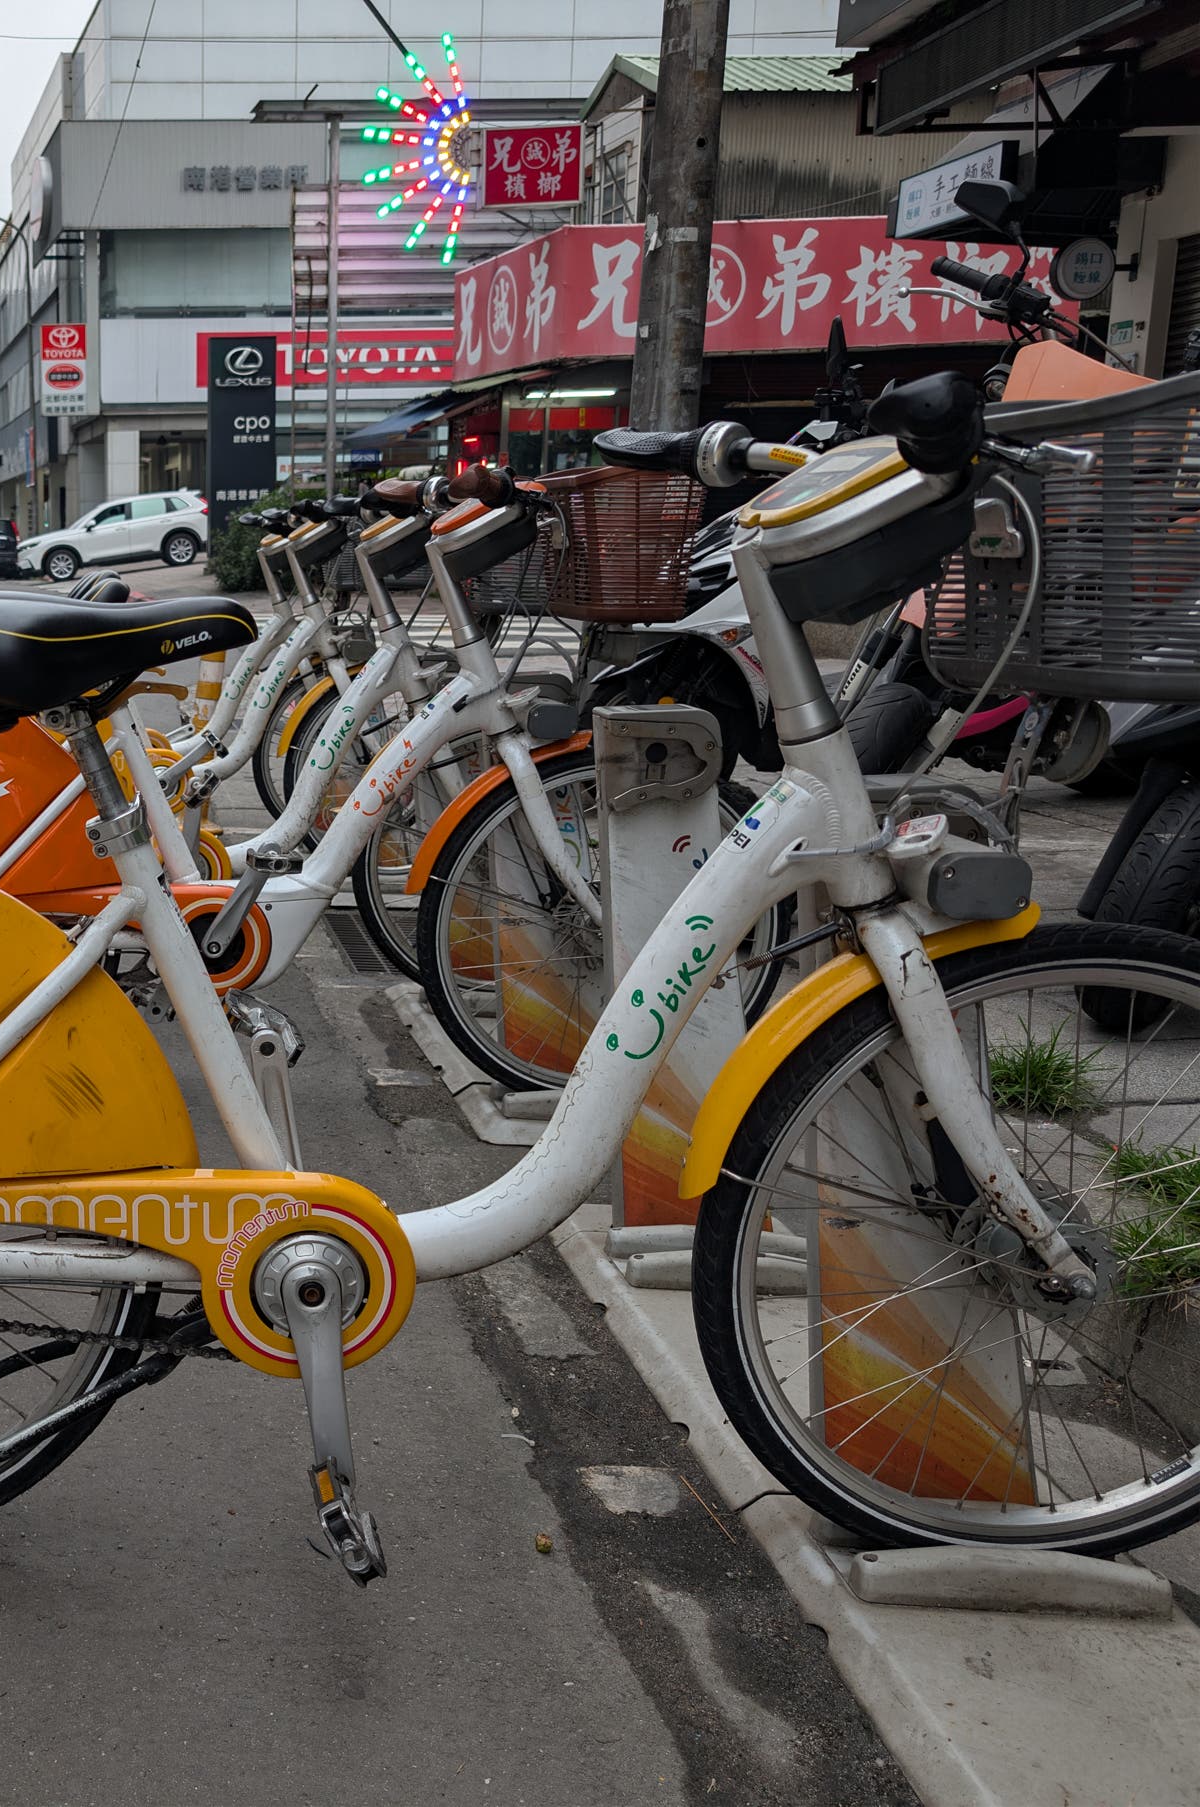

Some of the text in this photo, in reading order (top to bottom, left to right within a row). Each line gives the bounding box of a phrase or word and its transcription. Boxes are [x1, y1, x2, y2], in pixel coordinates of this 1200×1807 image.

[488, 130, 577, 174] 兄誠弟
[504, 171, 562, 200] 檳榔
[456, 240, 557, 365] 兄誠弟
[44, 349, 84, 359] TOYOTA
[276, 344, 441, 375] TOYOTA
[215, 377, 272, 387] LEXUS
[234, 416, 271, 434] cpo
[175, 631, 209, 650] VELO
[216, 1200, 310, 1289] momentum
